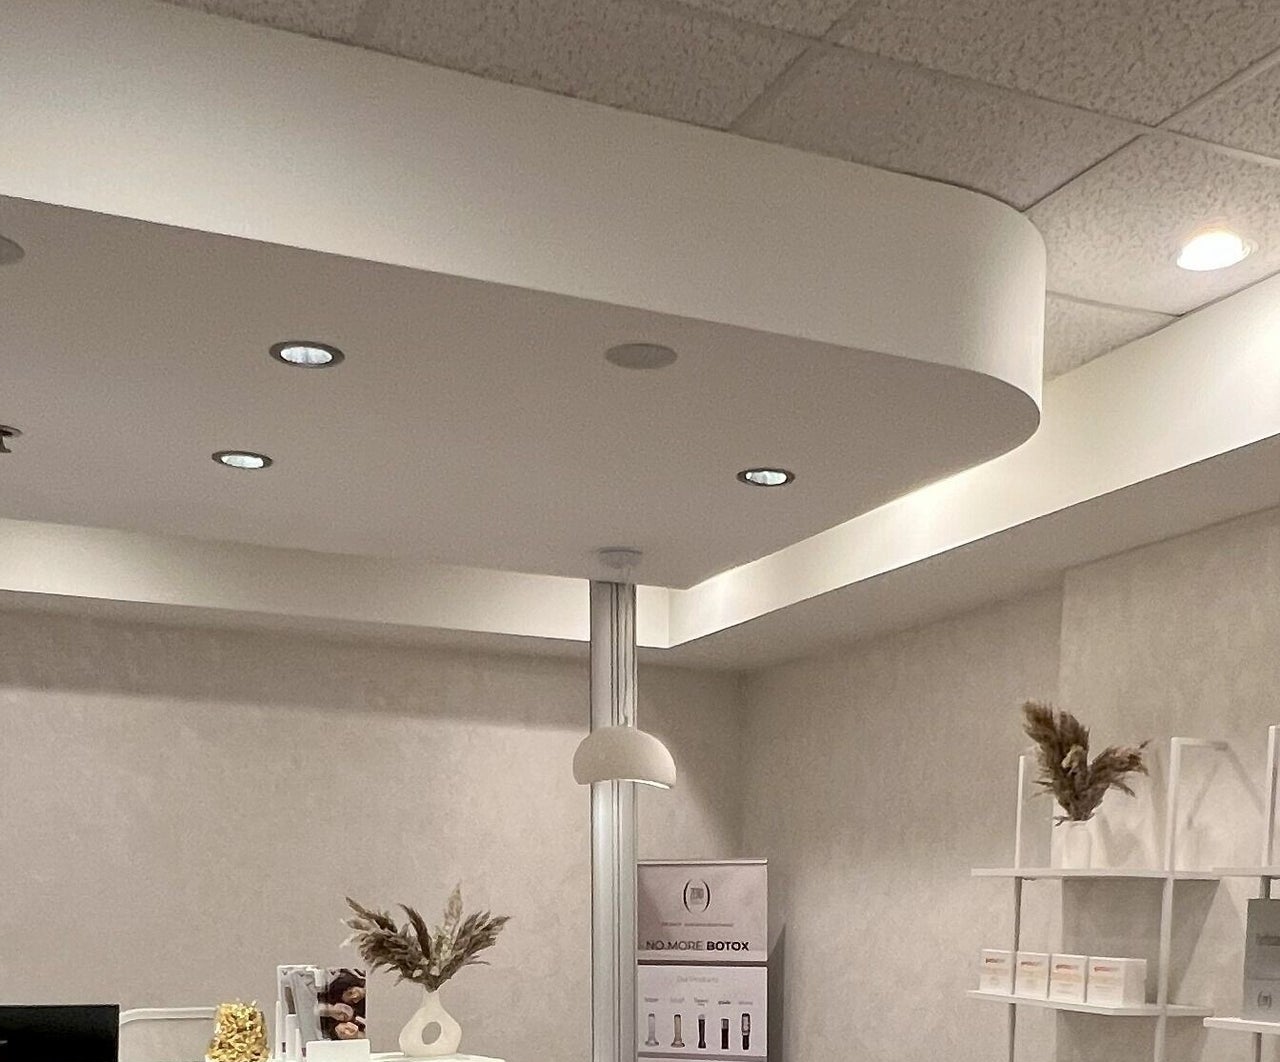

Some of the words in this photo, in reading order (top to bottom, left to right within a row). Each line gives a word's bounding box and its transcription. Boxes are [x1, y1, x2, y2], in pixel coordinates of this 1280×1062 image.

[645, 940, 665, 951] NO
[668, 940, 704, 951] MORE
[706, 941, 750, 951] BOTOX
